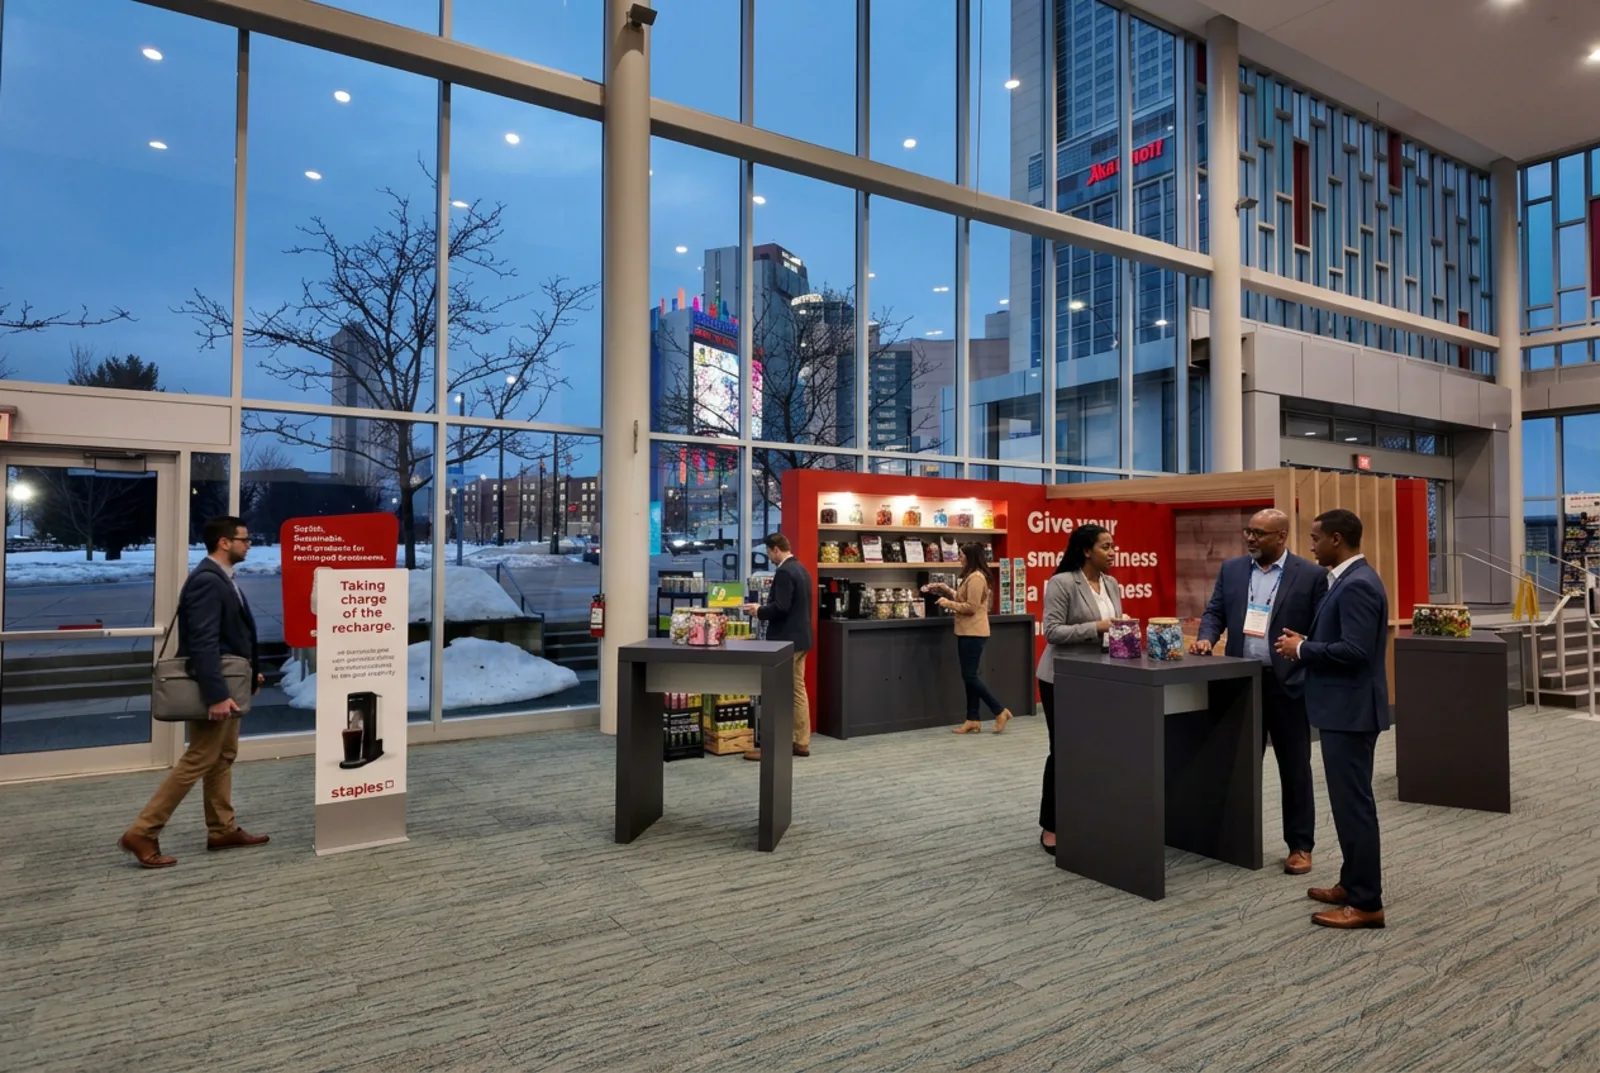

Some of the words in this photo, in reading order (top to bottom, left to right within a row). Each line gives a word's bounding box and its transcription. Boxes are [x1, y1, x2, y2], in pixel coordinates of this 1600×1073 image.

[1086, 138, 1163, 186] Maiott
[1027, 510, 1073, 534] Give
[1076, 518, 1118, 536] yur
[1110, 546, 1158, 567] iness
[340, 580, 385, 592] Taking
[1027, 584, 1038, 601] a
[341, 594, 387, 606] charge
[343, 607, 357, 618] of
[361, 607, 382, 618] the
[332, 622, 395, 633] recharge.
[331, 783, 383, 798] staples
